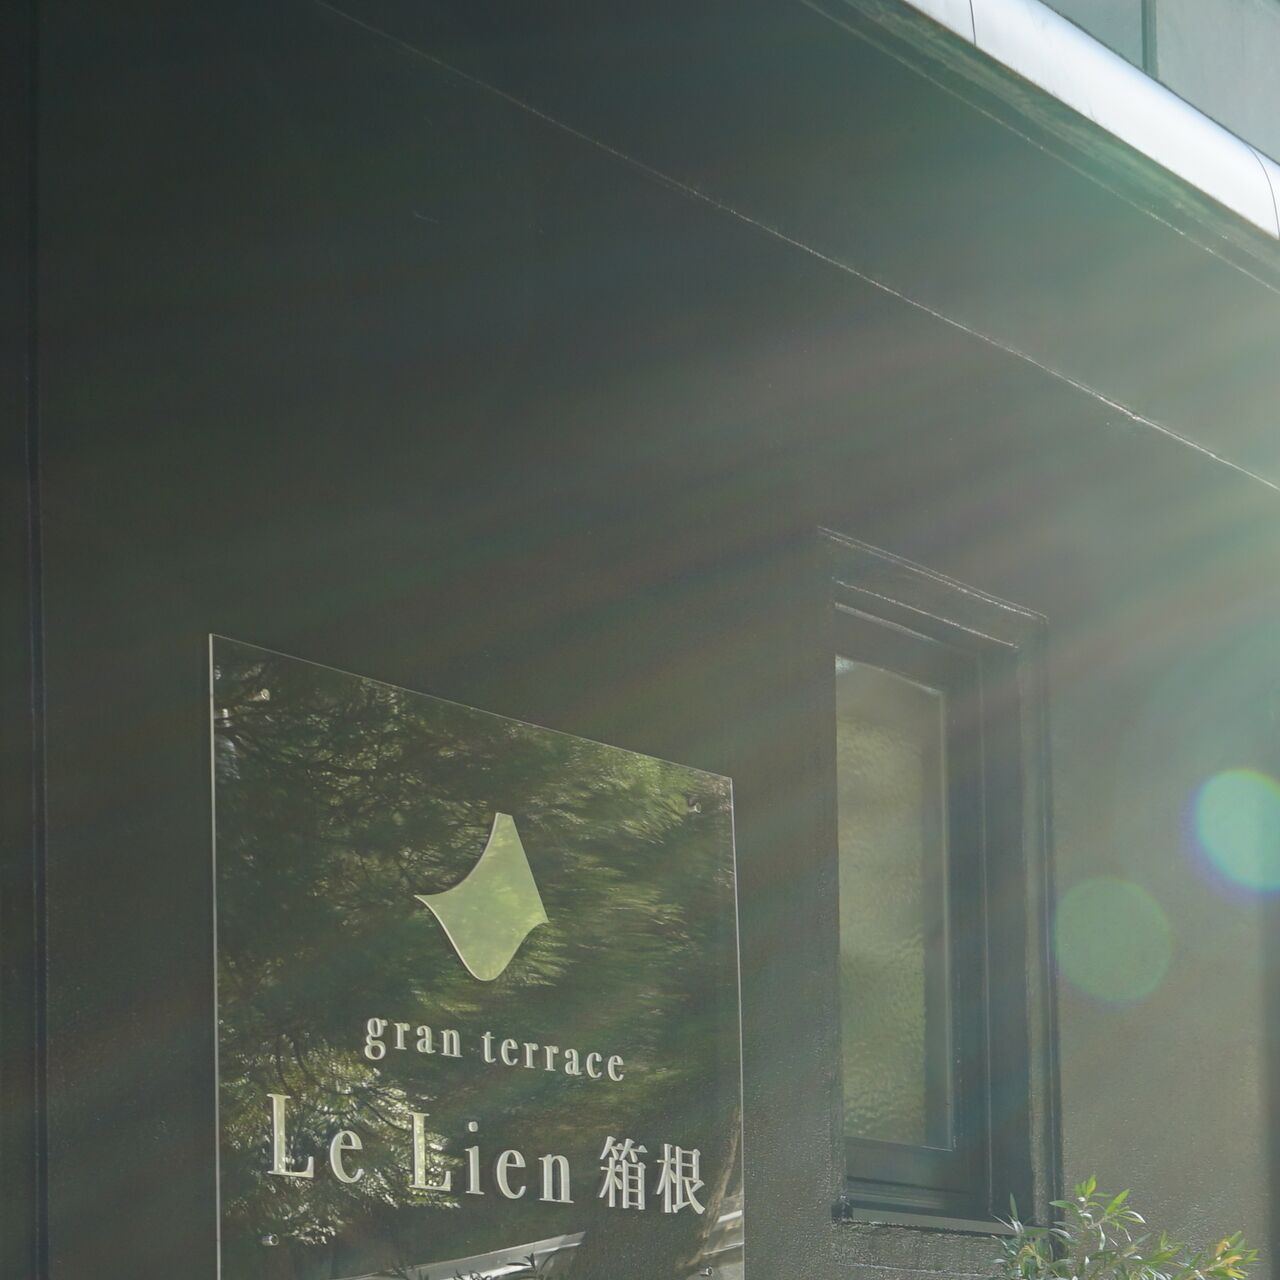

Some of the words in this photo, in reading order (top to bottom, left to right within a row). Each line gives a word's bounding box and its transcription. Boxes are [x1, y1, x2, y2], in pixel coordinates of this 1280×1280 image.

[363, 1016, 463, 1061] gran
[482, 1031, 626, 1082] terrace
[266, 1093, 364, 1184] Le
[409, 1112, 574, 1204] Lien
[599, 1135, 706, 1215] 箱根
